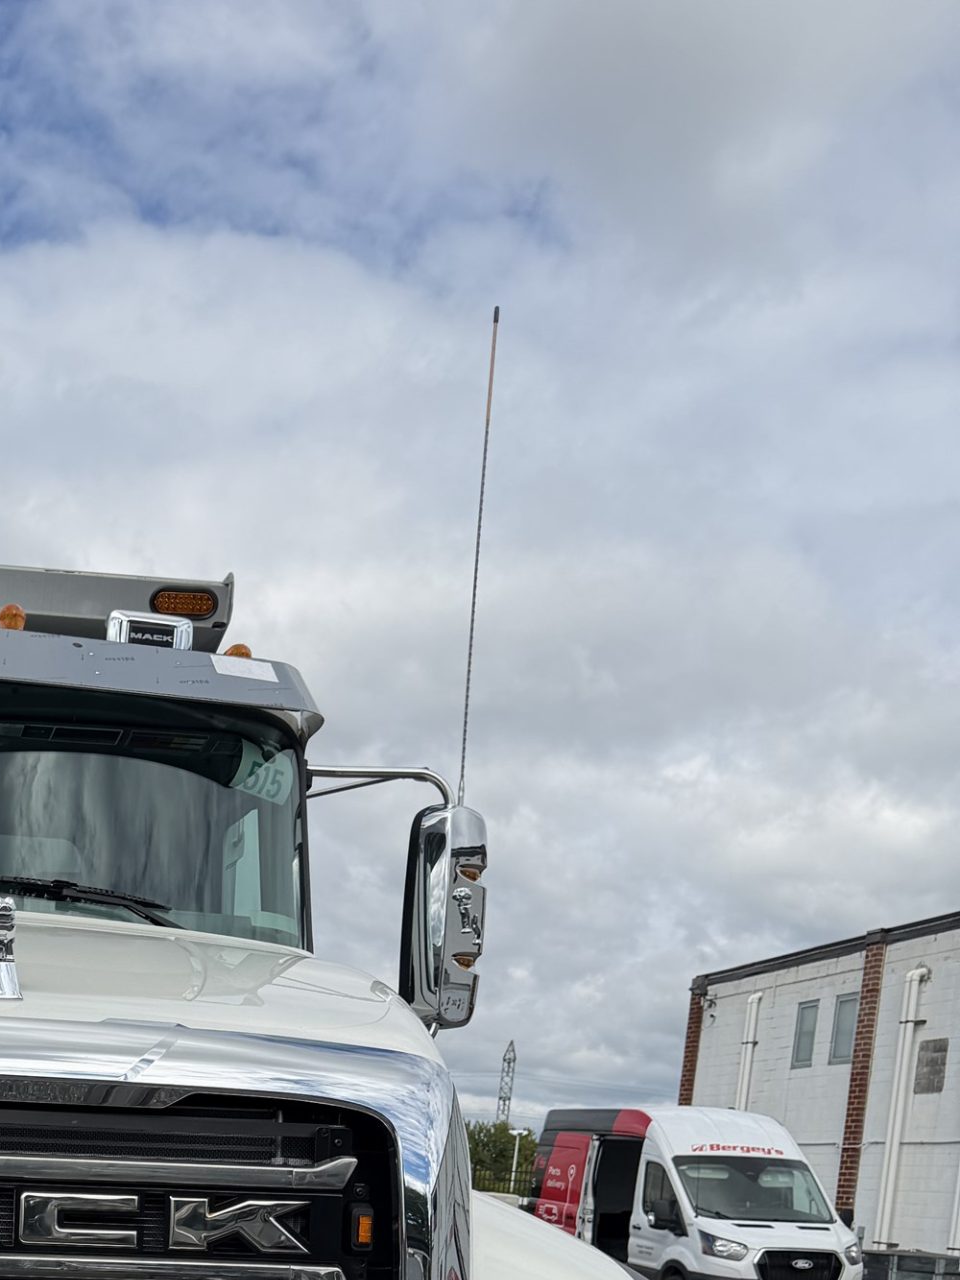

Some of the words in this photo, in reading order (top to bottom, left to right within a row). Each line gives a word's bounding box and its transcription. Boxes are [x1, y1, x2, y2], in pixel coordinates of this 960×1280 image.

[129, 631, 174, 643] MACK
[243, 760, 285, 799] 515
[708, 1143, 785, 1156] Bergey's
